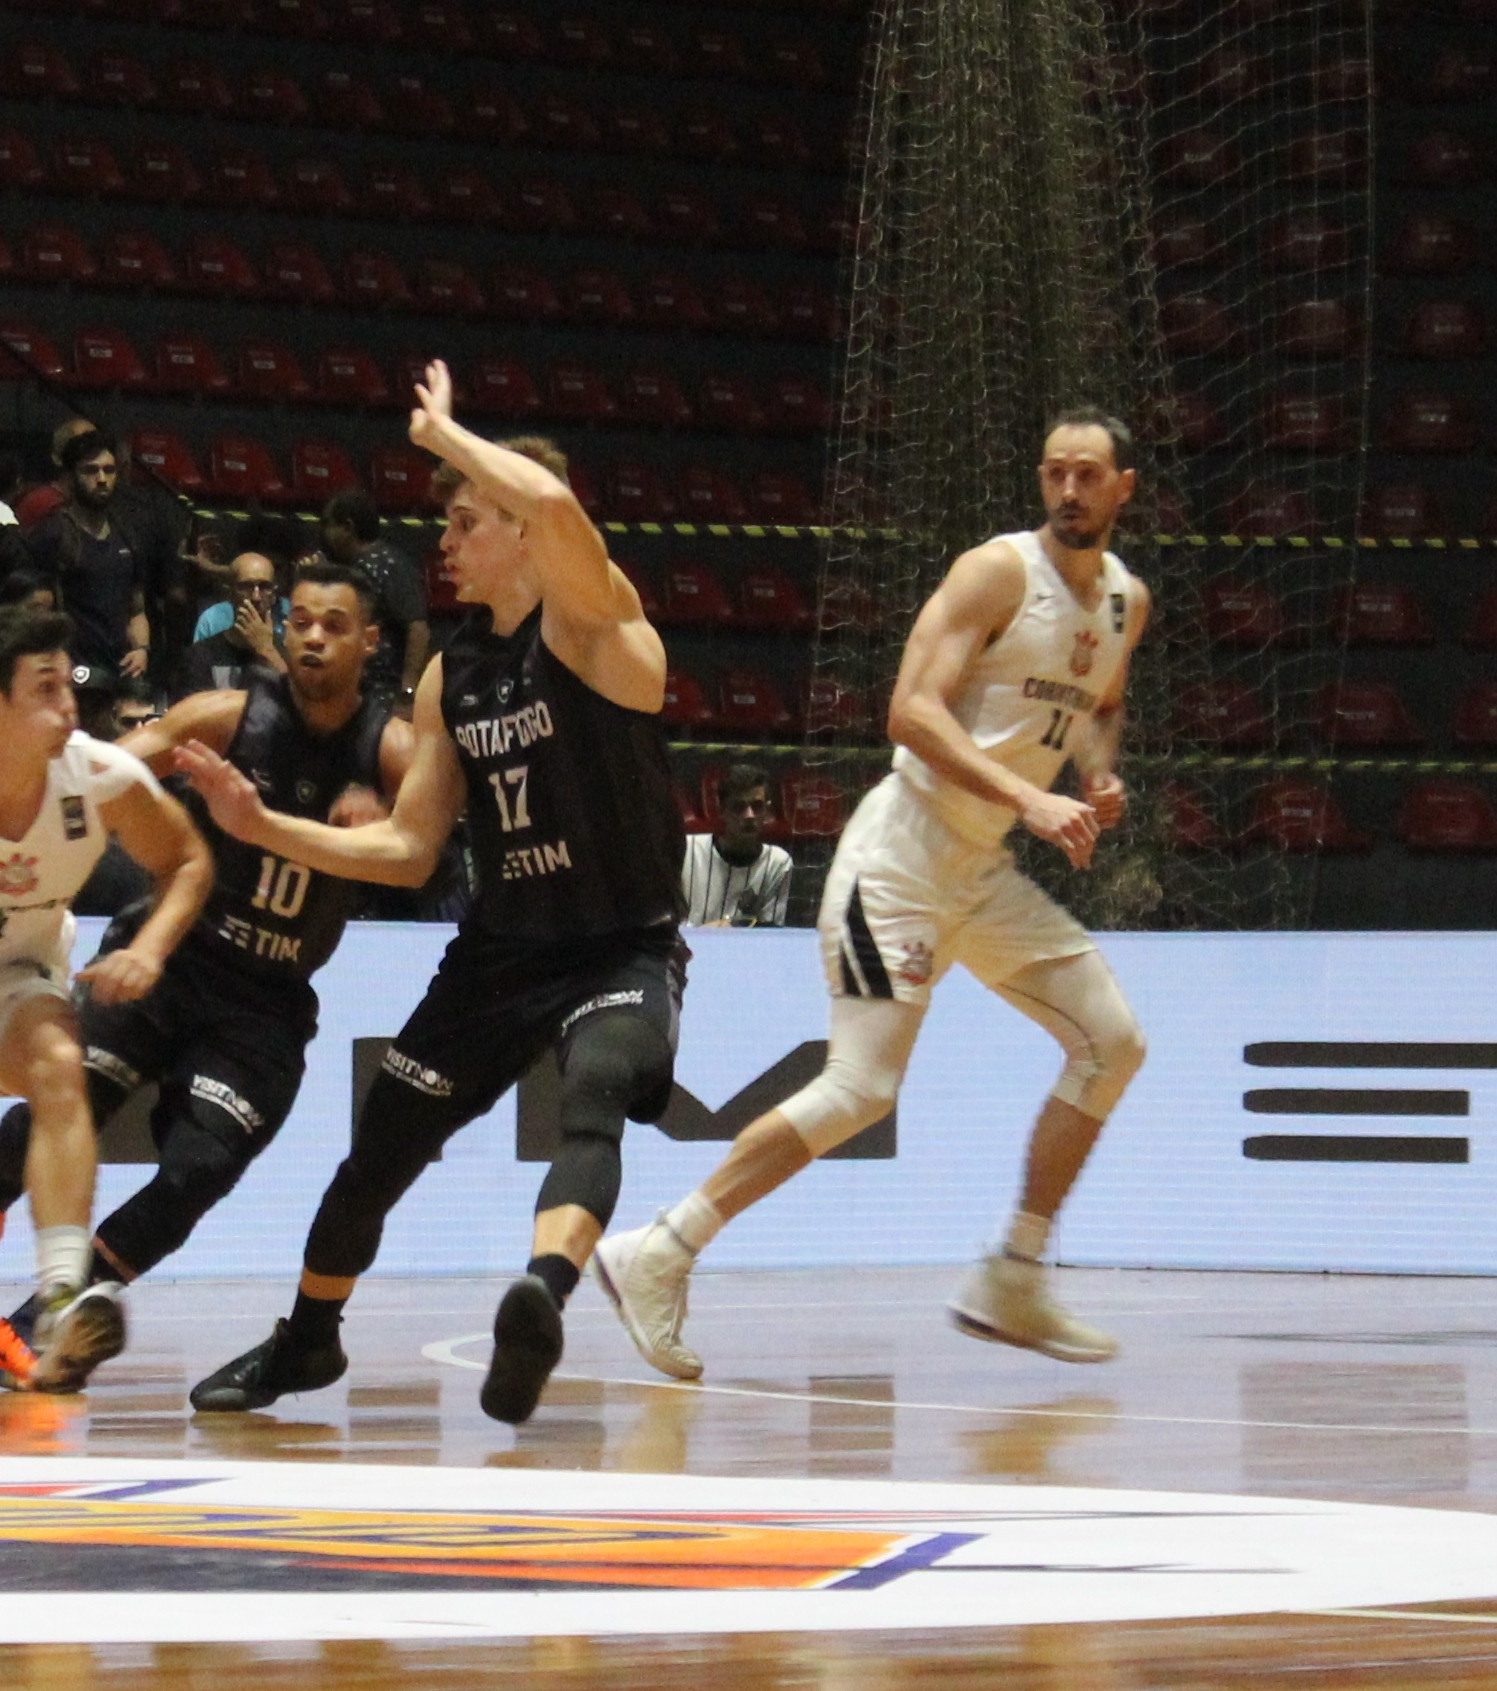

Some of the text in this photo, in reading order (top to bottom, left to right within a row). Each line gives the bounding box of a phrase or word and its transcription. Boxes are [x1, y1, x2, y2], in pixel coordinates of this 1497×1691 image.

[1039, 708, 1074, 750] 11
[488, 766, 532, 832] 17
[517, 840, 573, 876] TIM
[251, 856, 311, 919] 10
[255, 927, 302, 962] TIM
